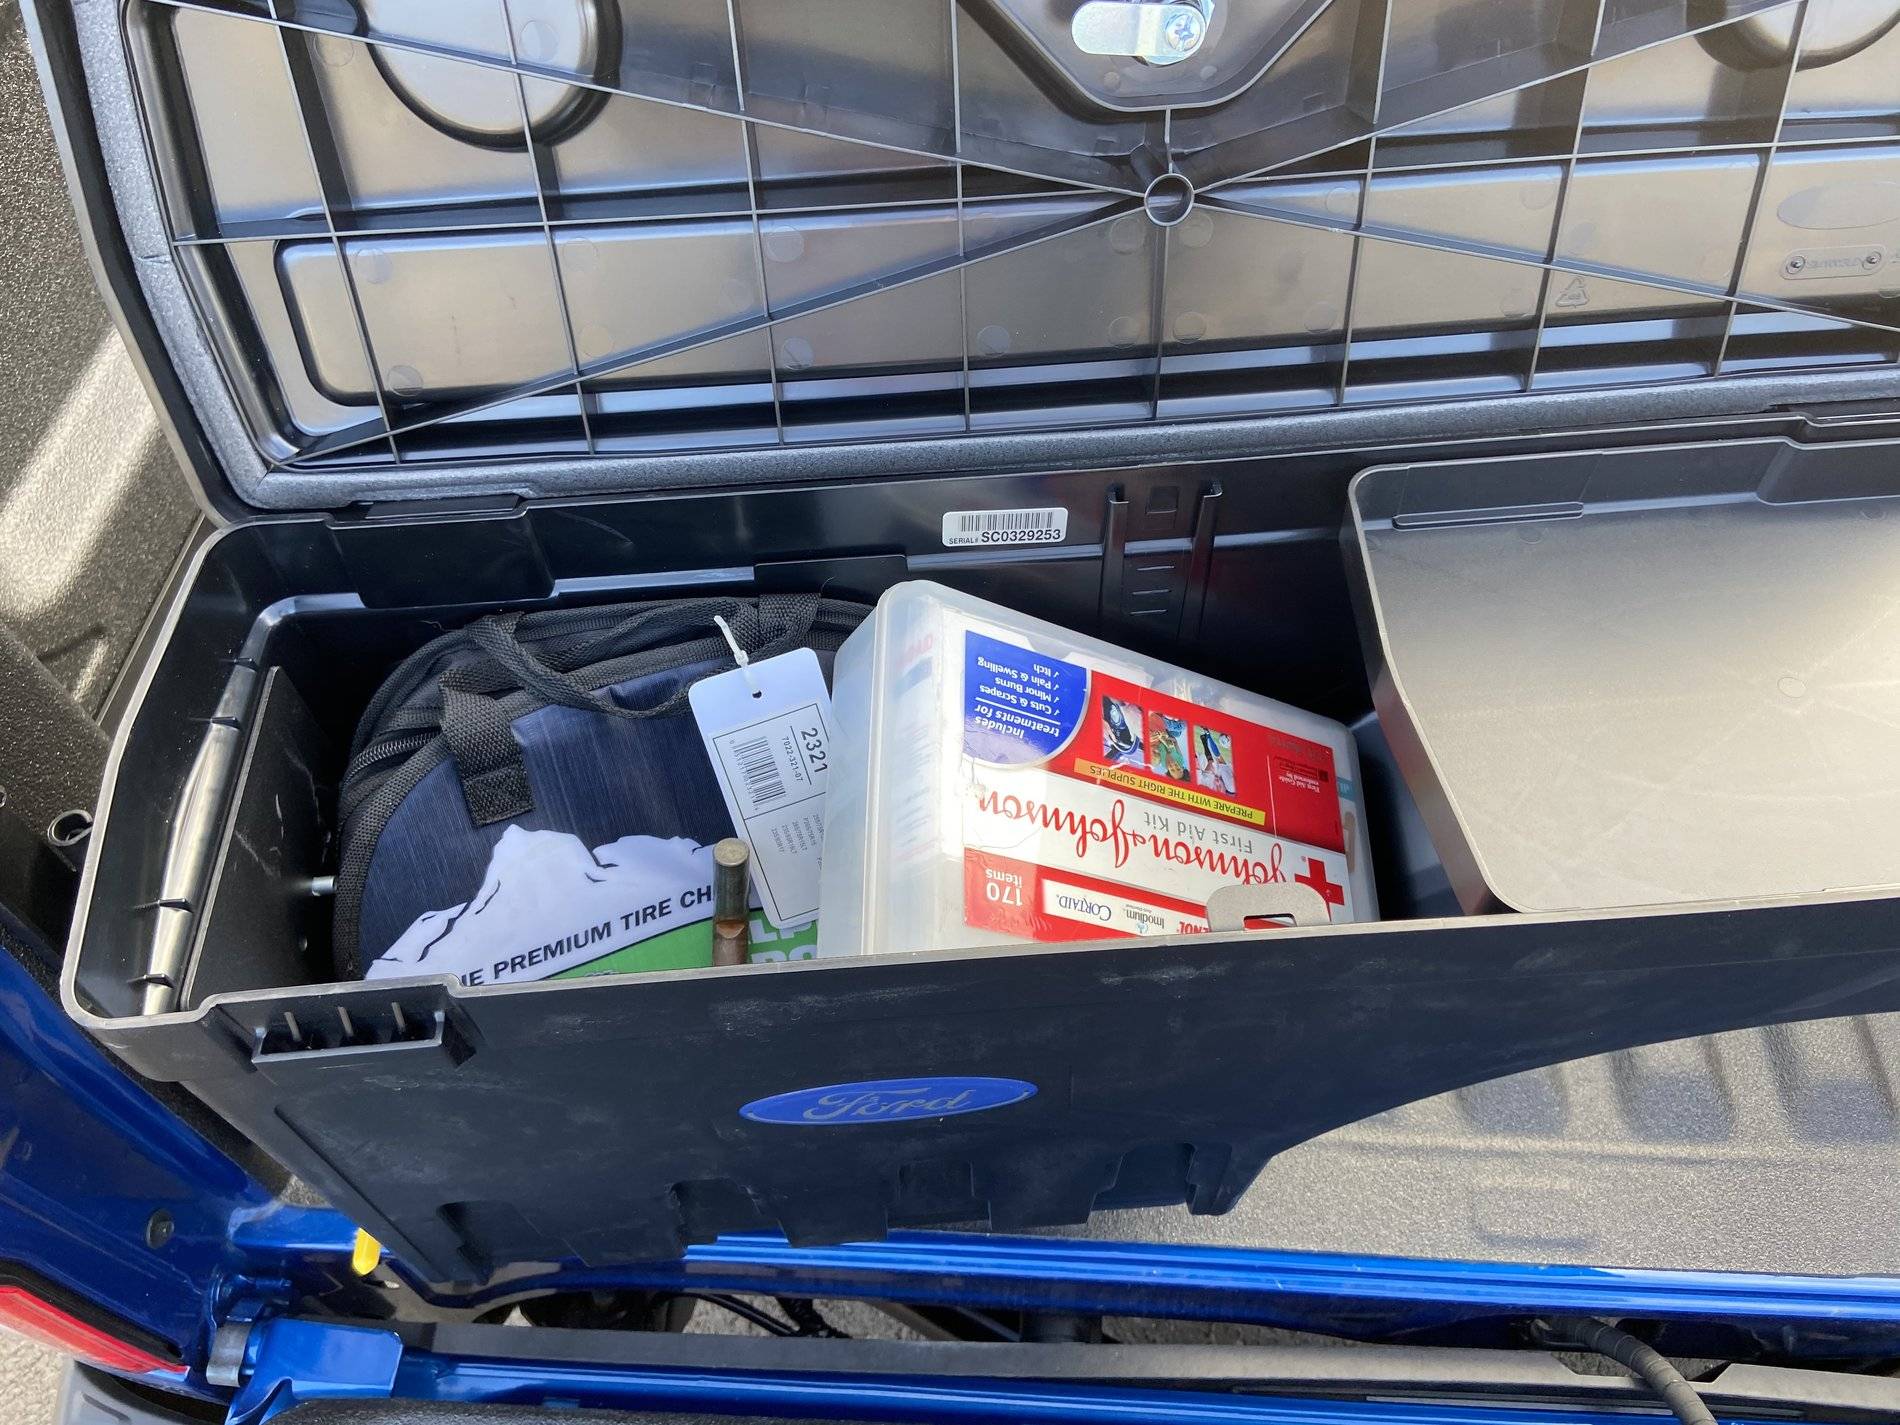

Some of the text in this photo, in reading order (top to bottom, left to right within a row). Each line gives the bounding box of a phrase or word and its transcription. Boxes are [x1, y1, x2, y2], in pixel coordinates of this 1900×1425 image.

[981, 528, 1061, 543] SC0329253
[977, 656, 1052, 689] Pain & Swelling
[1033, 663, 1052, 677] Itch
[979, 685, 1052, 715] Cuts & Scrapes
[995, 676, 1052, 702] Minor Burns
[974, 704, 1060, 738] treatments for
[974, 716, 1025, 739] Includes
[782, 736, 804, 782] 7022-321-07
[801, 727, 828, 773] 2321
[1089, 765, 1253, 819] PREPARE WITH THE RIGHT SUPPLIES
[978, 789, 1133, 868] Johnson
[1143, 811, 1254, 855] First Aid Kit
[985, 868, 1022, 887] items
[1149, 843, 1288, 886] Johnson
[986, 881, 1023, 907] 170
[1126, 909, 1165, 930] Imodium
[493, 921, 613, 980] PREMIUM
[620, 898, 672, 932] TIRE
[802, 1087, 976, 1121] Ford
